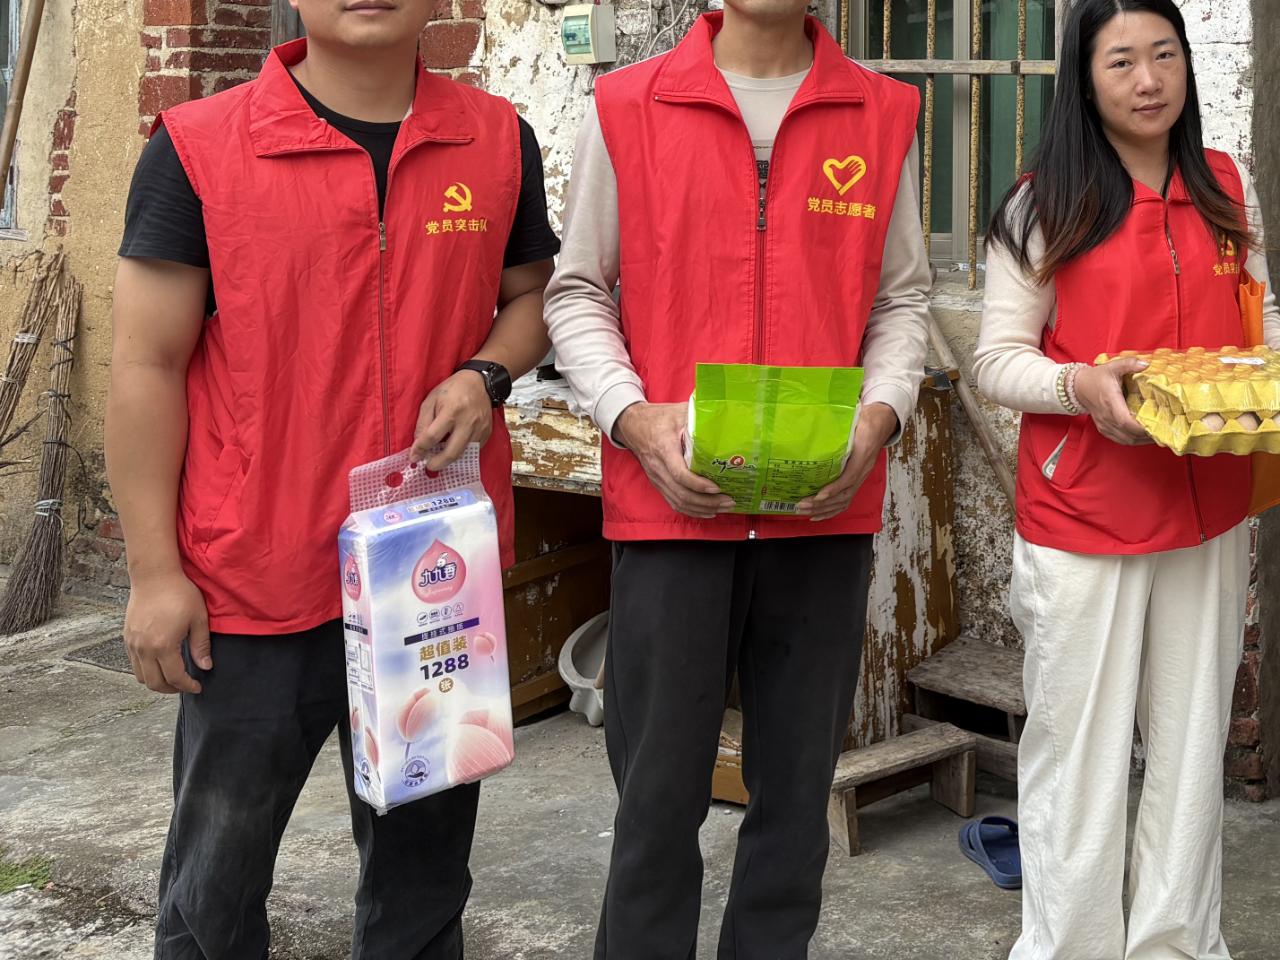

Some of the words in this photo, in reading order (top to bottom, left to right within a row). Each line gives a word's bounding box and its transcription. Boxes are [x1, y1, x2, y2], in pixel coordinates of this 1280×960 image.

[807, 197, 877, 220] 党员志愿者
[425, 218, 488, 235] 党员突击队
[418, 561, 457, 587] 九九香
[419, 635, 468, 662] 超值装
[419, 653, 470, 681] 1288
